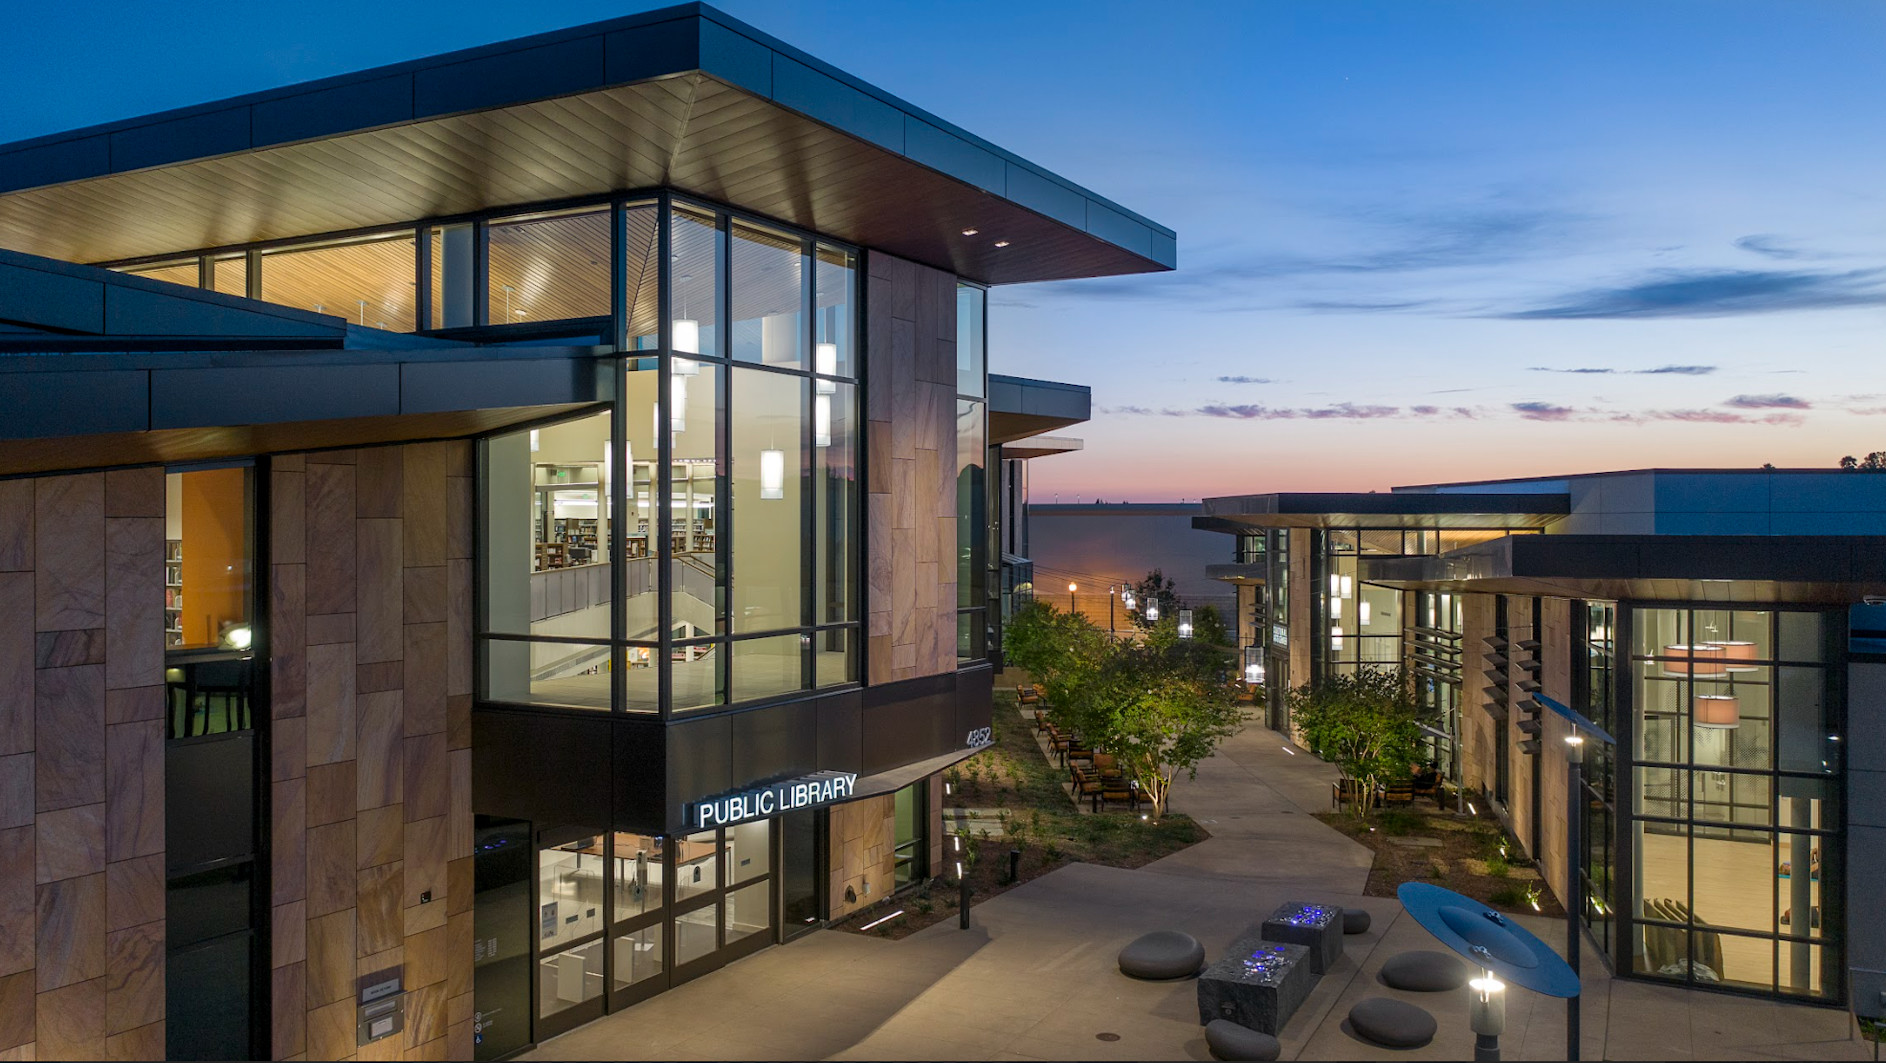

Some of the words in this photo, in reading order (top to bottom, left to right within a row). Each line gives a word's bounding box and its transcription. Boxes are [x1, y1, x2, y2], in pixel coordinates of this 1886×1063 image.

[966, 726, 991, 747] 4852
[700, 791, 774, 828] PUBLIC
[780, 774, 858, 811] LIBRARY
